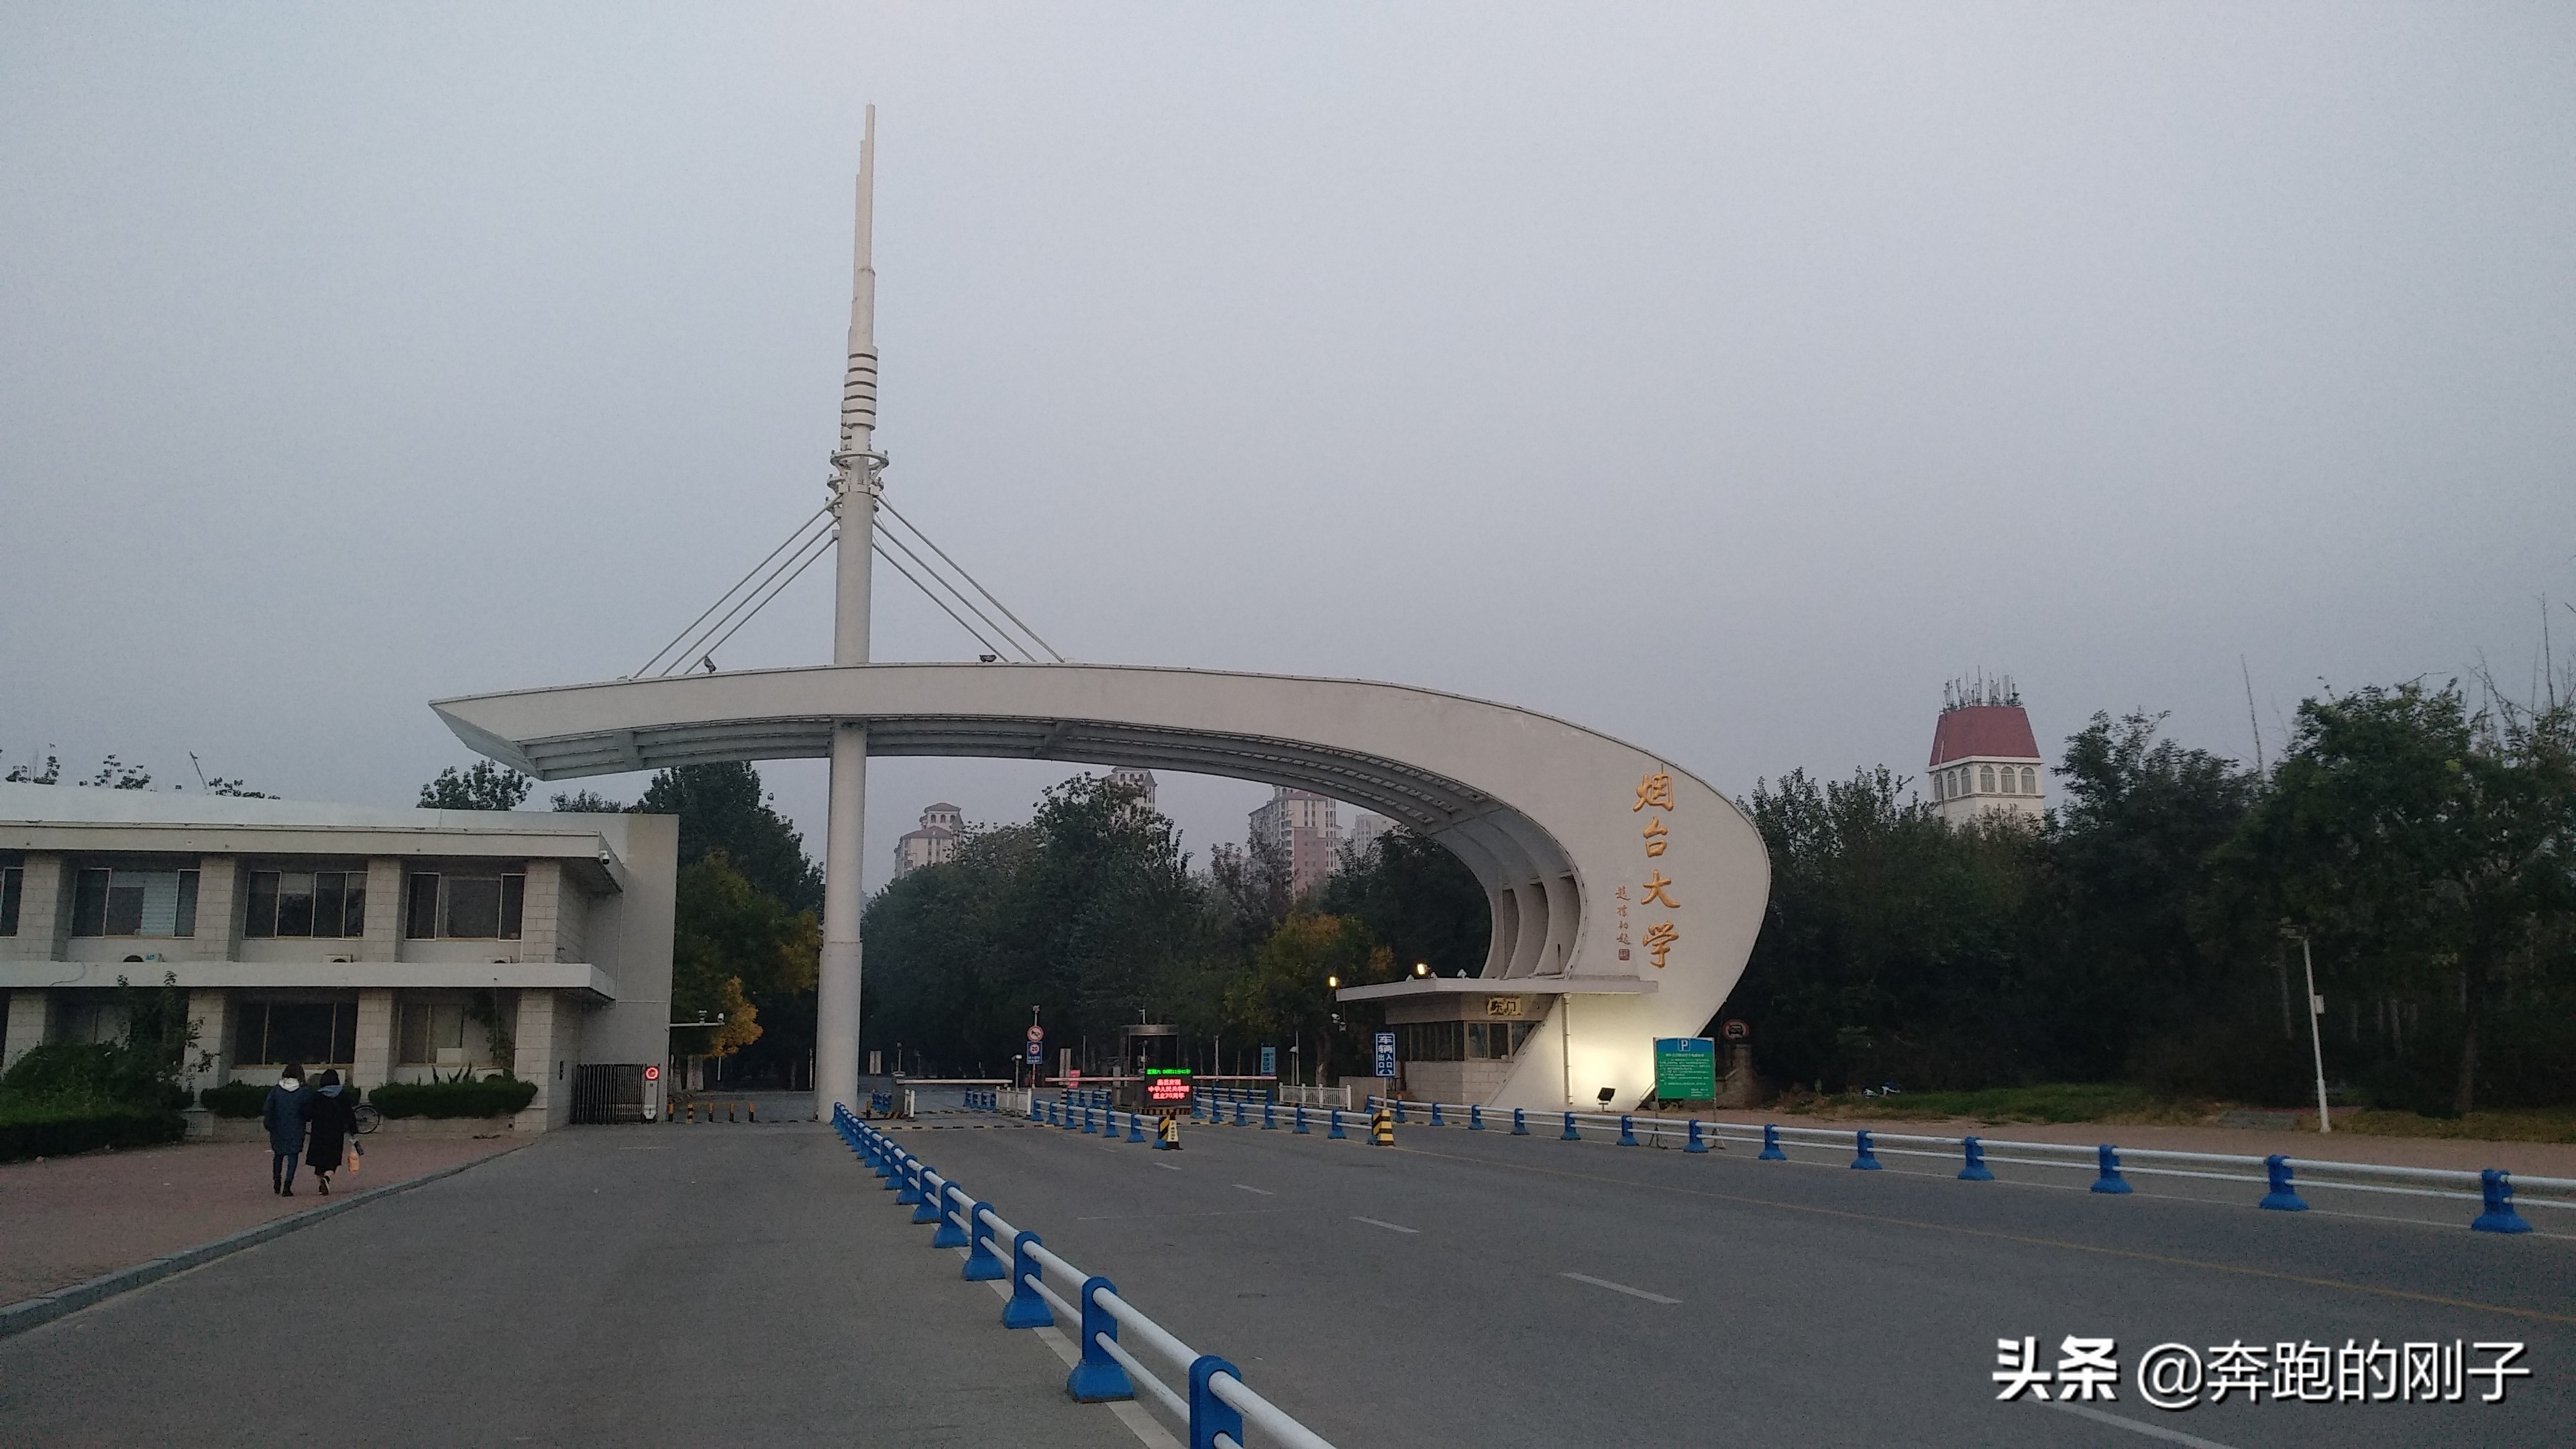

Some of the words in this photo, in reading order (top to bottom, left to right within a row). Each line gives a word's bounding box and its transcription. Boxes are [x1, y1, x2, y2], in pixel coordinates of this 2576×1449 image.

[1632, 773, 1681, 968] 烟台大学
[1378, 1036, 1393, 1053] 车辆
[1681, 1040, 1688, 1051] P
[1378, 1055, 1385, 1069] 出口
[1385, 1054, 1393, 1069] 入口
